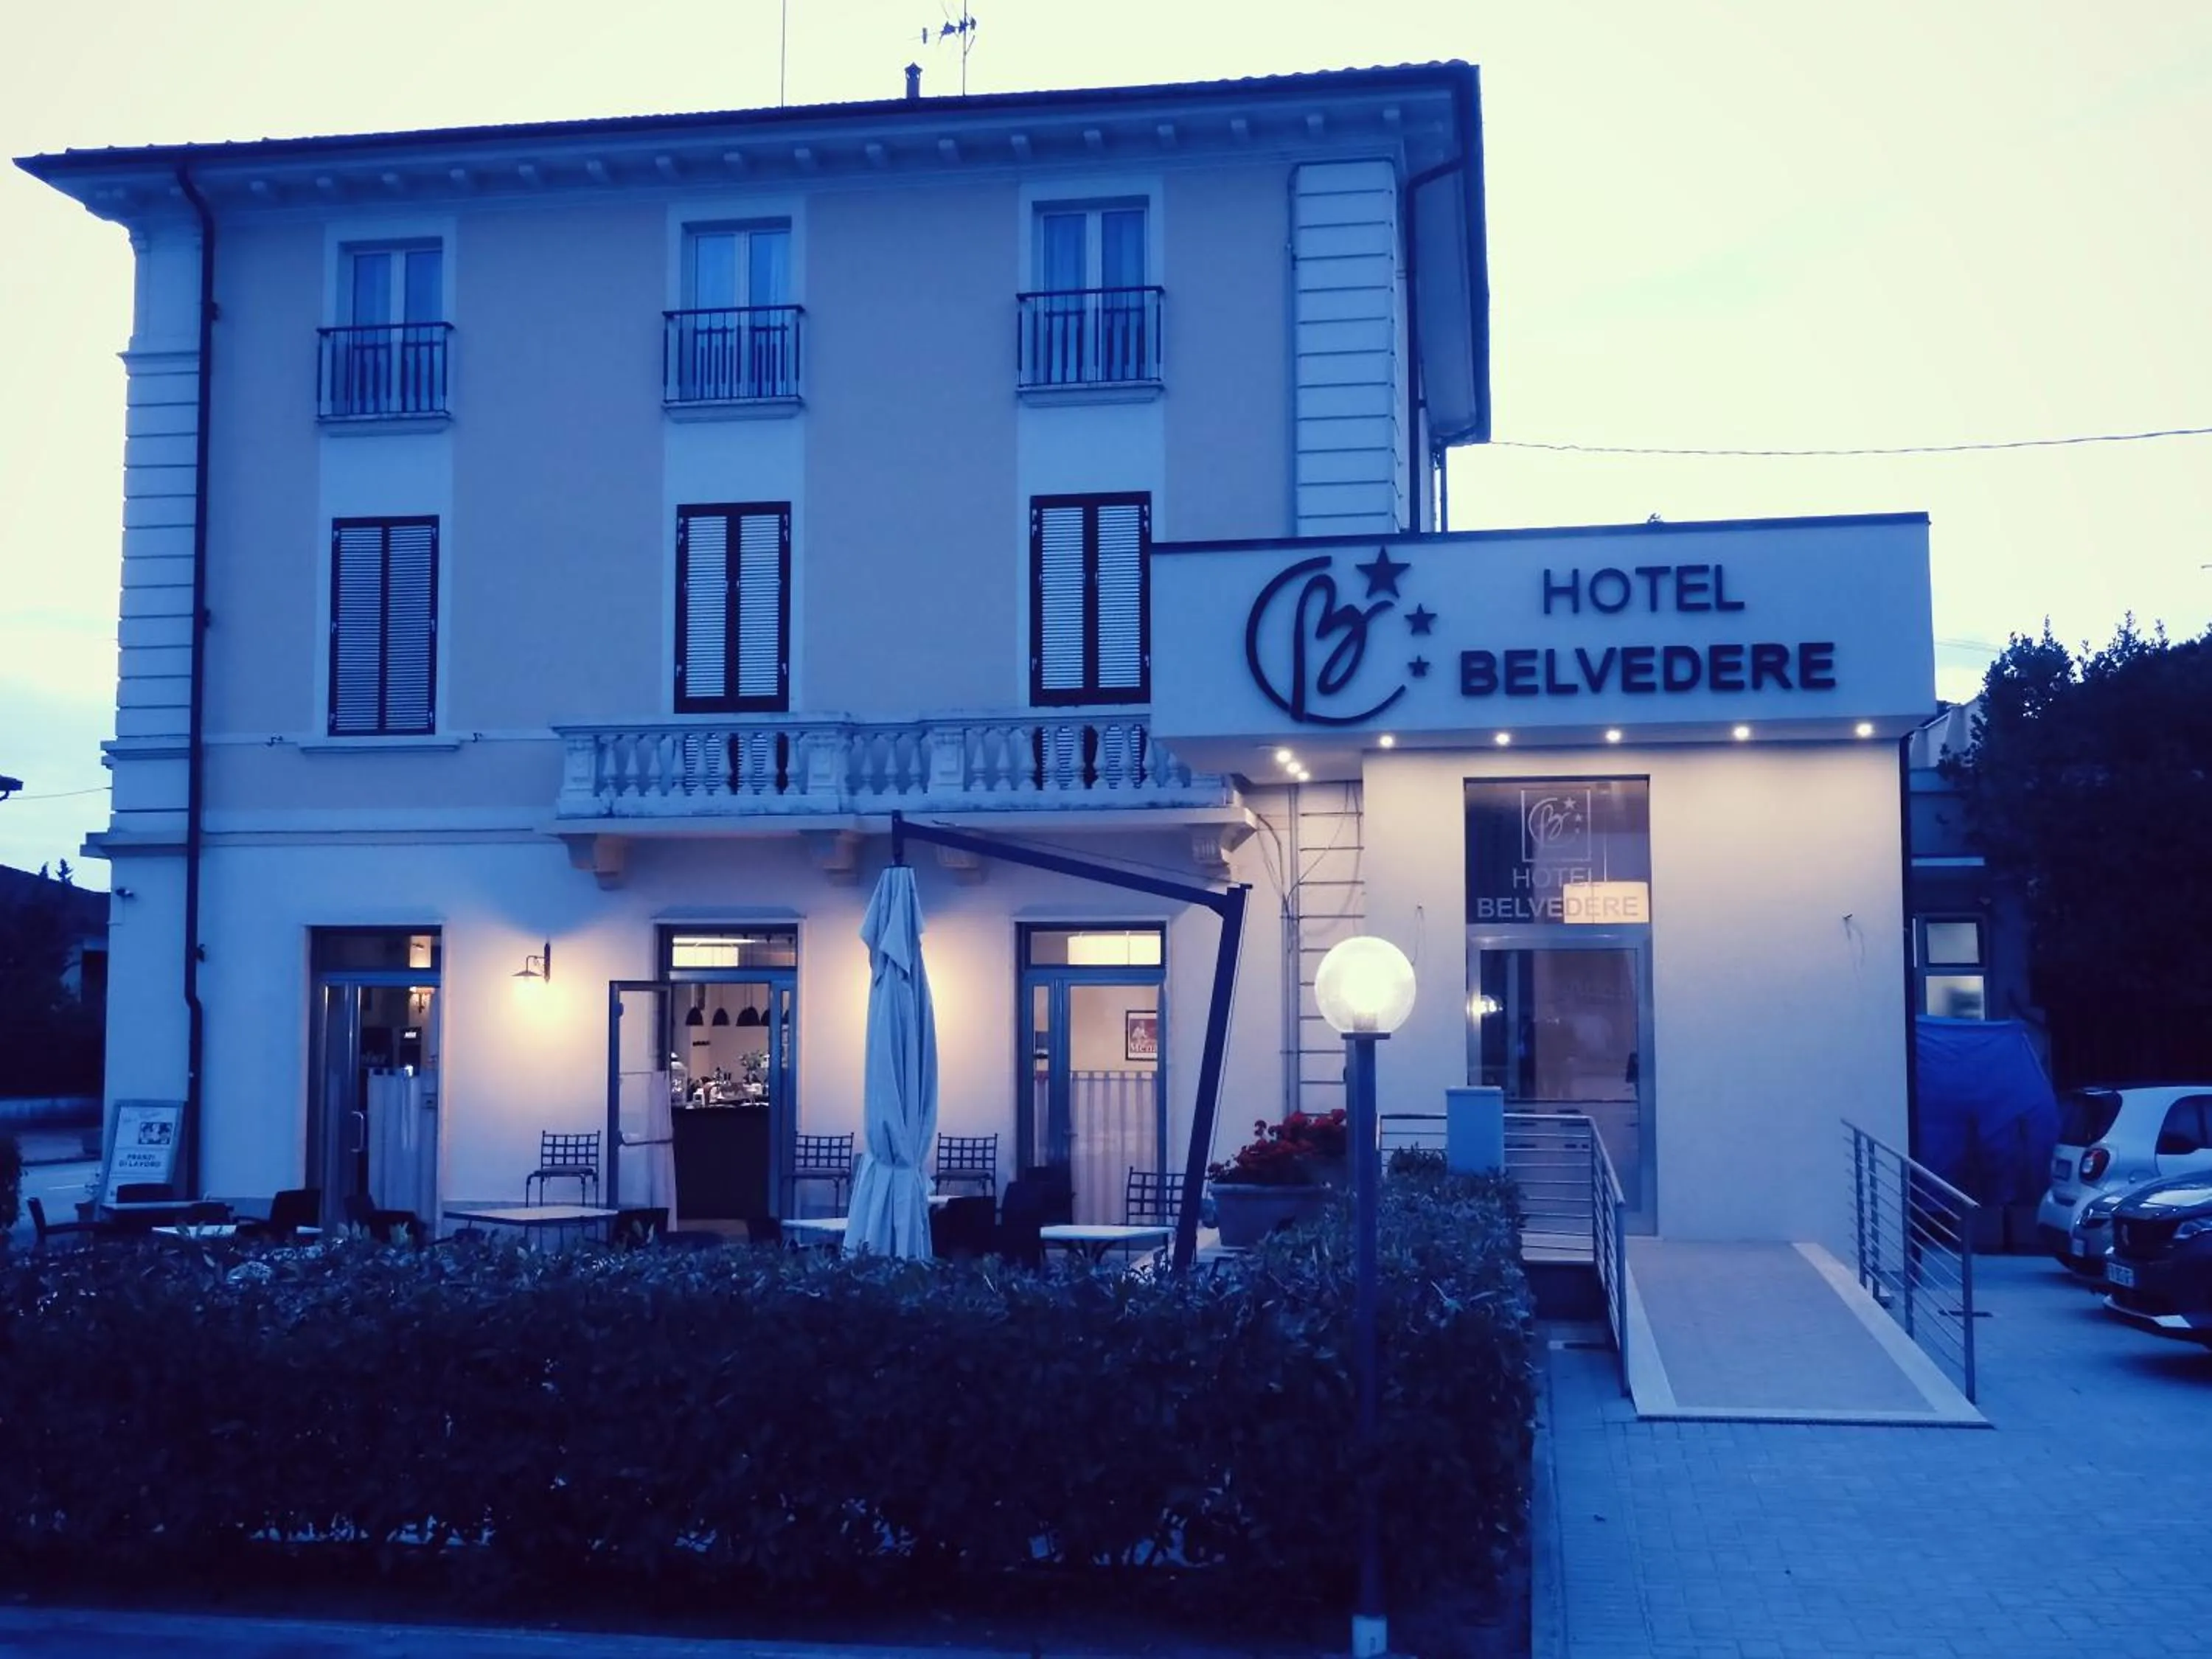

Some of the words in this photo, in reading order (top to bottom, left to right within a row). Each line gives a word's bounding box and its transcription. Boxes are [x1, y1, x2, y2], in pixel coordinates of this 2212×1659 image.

[1543, 563, 1745, 615] HOTEL
[1459, 641, 1837, 698] BELVEDERE
[1513, 866, 1600, 888] HOTEL
[1477, 896, 1638, 918] BELVEDERE
